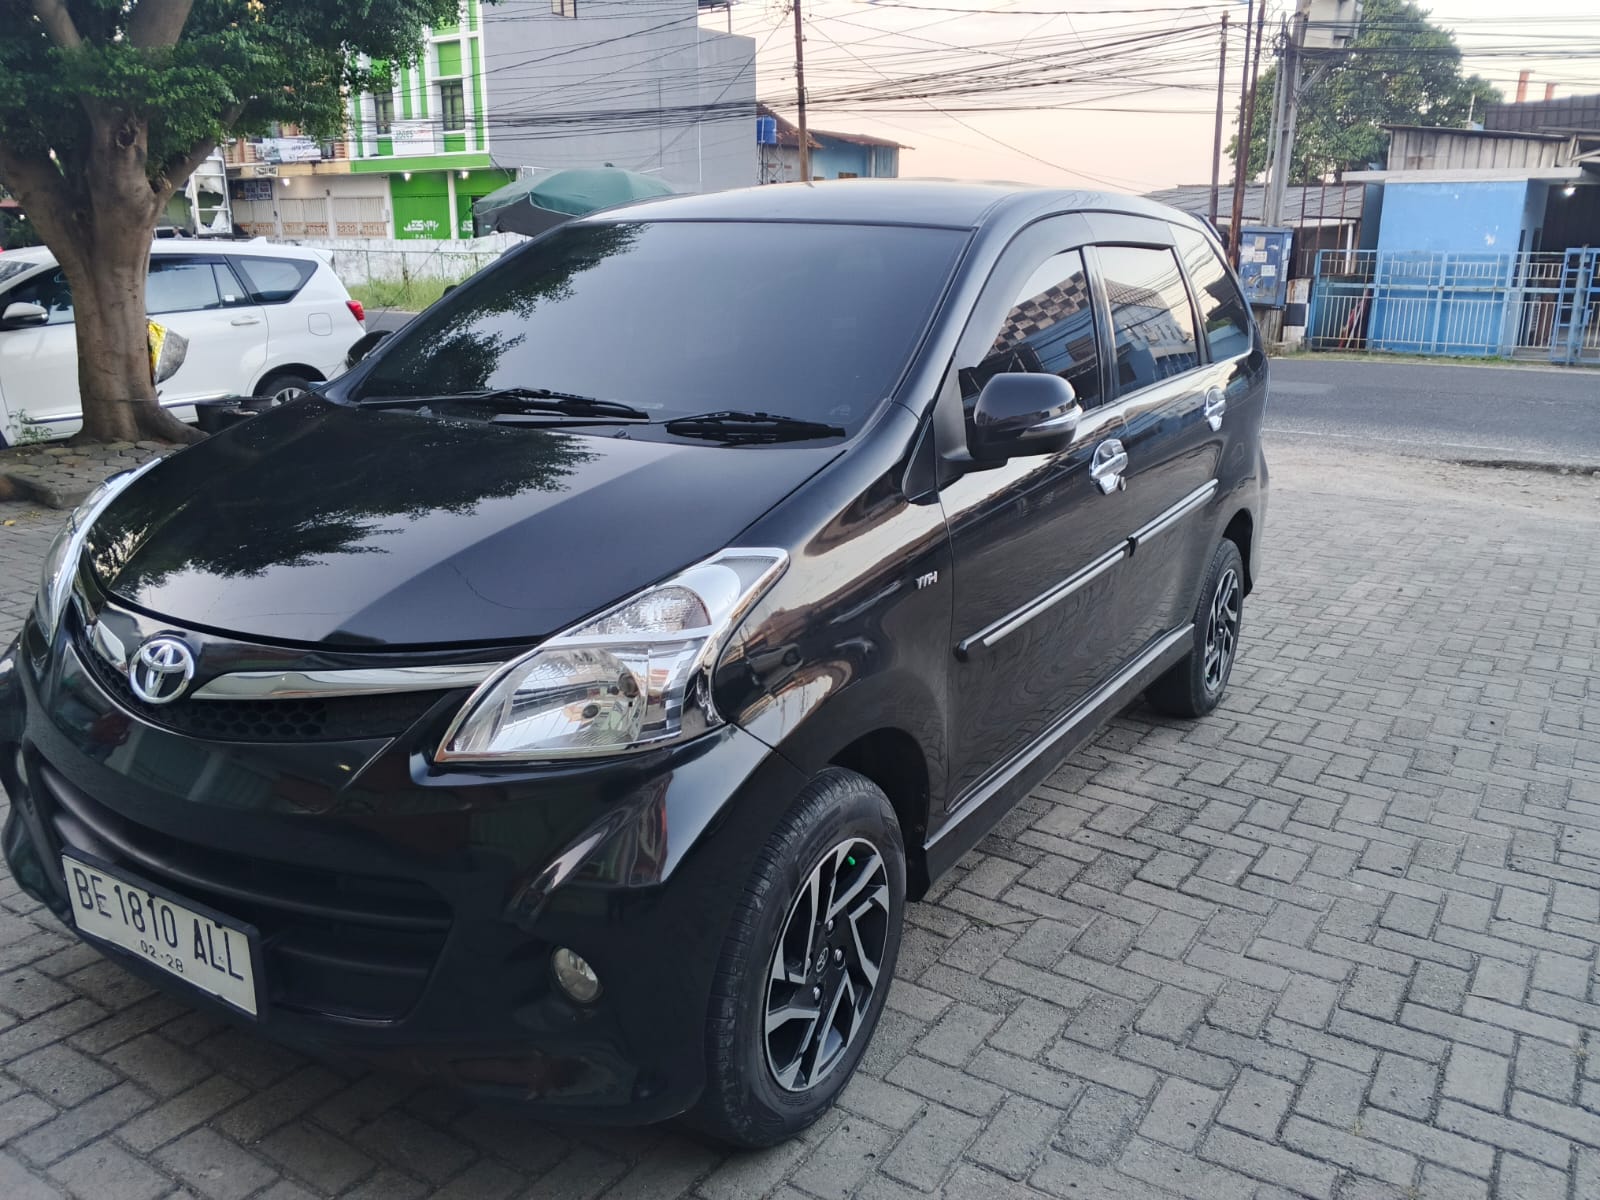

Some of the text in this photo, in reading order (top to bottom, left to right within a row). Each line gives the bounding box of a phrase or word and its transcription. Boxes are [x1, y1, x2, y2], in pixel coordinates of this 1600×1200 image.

[73, 867, 244, 981] BE 1810 ALL
